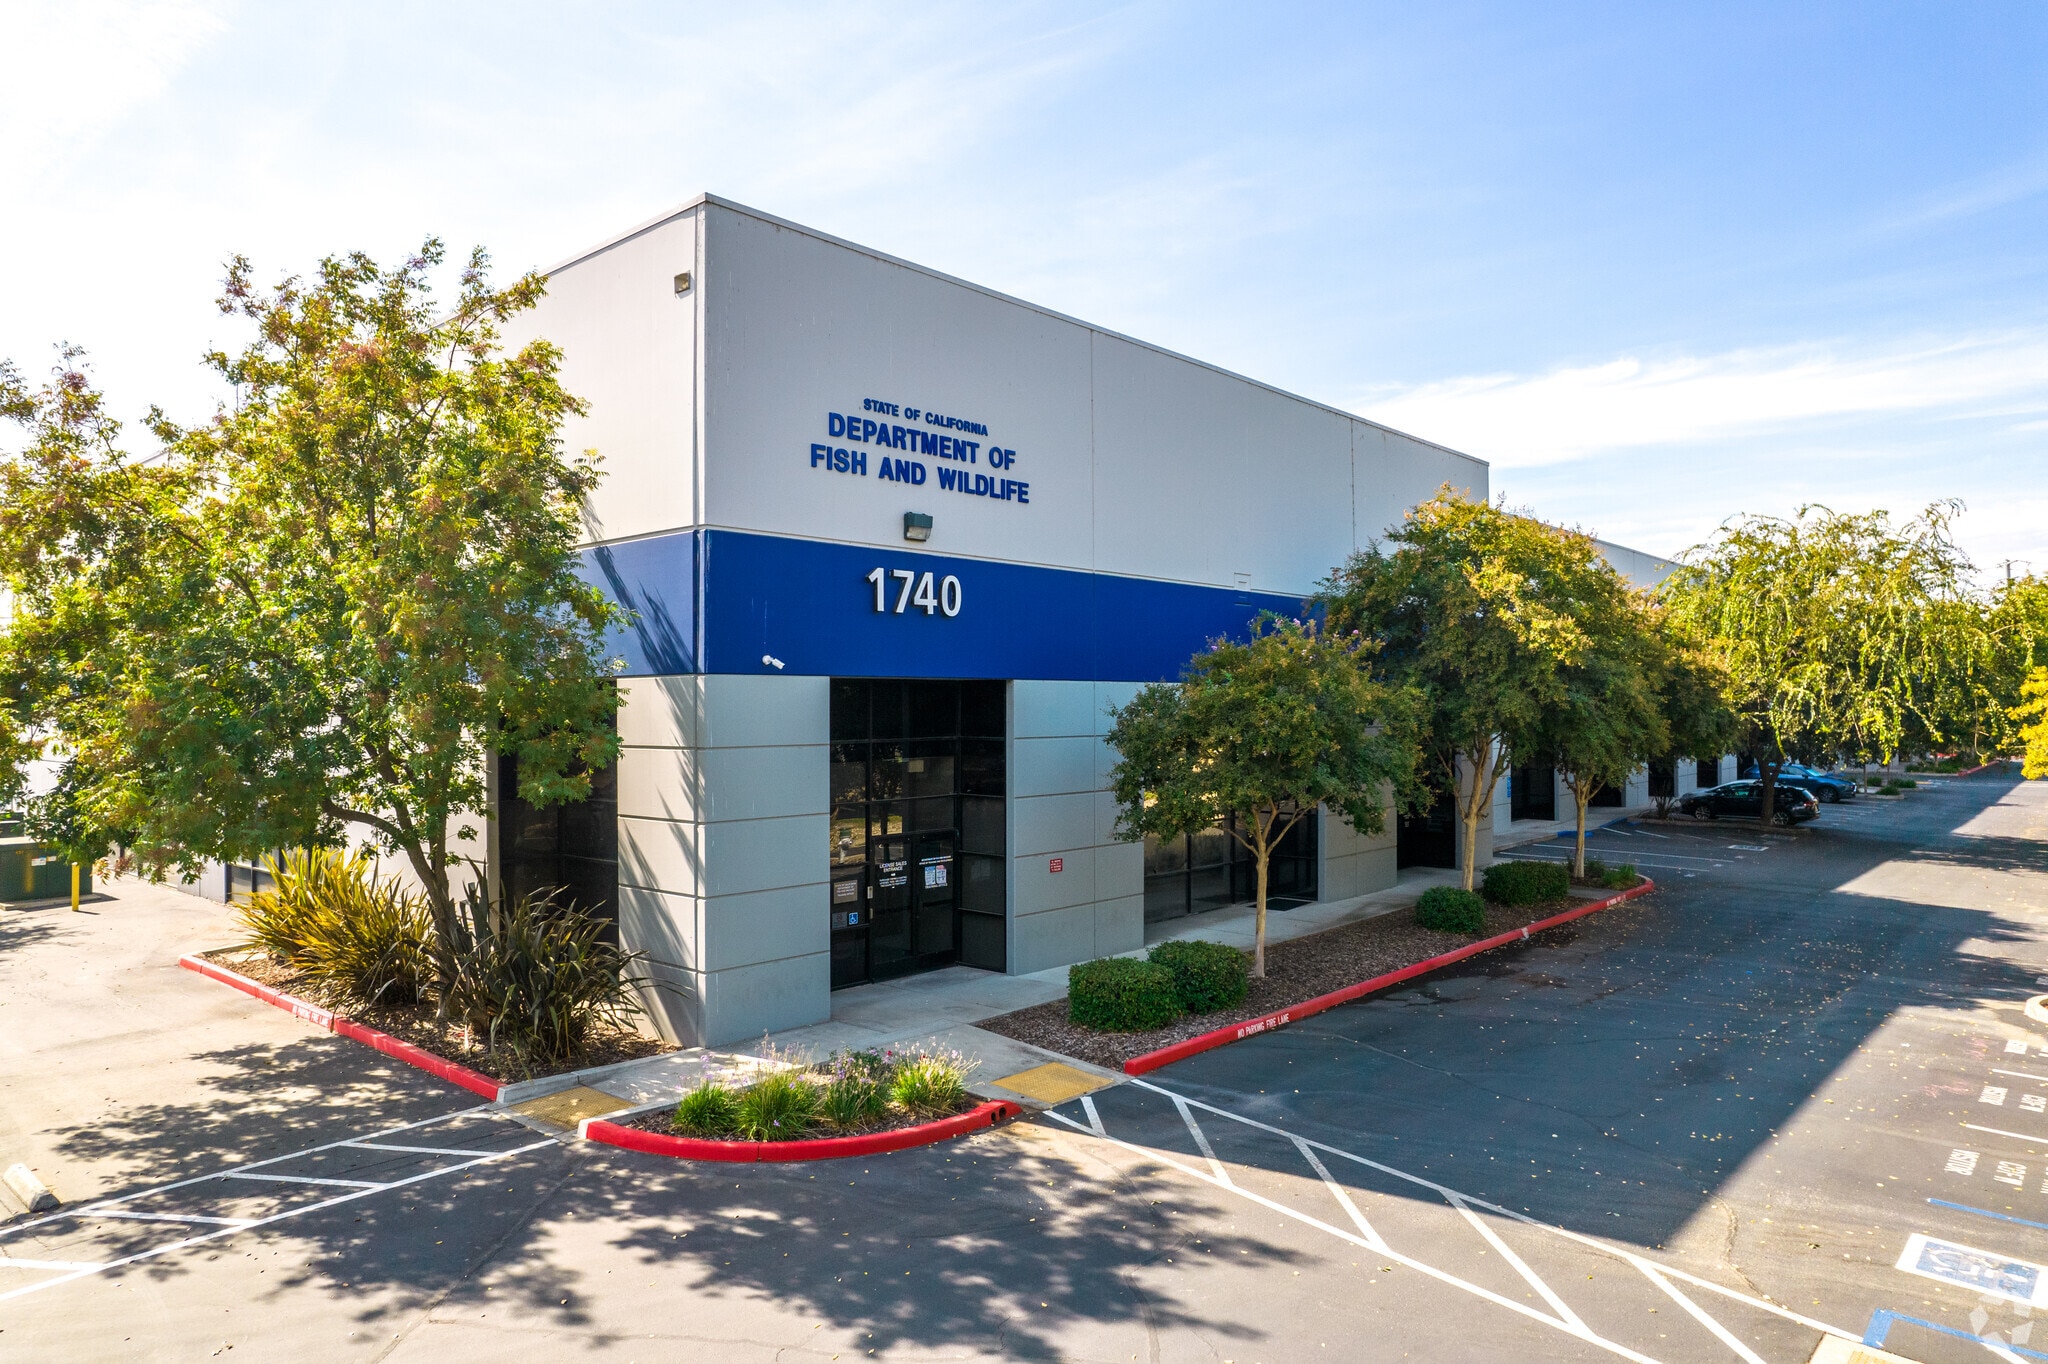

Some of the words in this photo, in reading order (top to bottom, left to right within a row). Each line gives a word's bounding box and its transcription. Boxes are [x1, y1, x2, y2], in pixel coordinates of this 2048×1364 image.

[828, 412, 980, 464] DEPARTMENT
[988, 446, 1016, 470] OF
[863, 398, 899, 417] STATE
[904, 407, 921, 421] OF
[925, 412, 988, 436] CALIFORNIA
[810, 443, 867, 476] FISH
[878, 457, 926, 485] AND
[937, 466, 1030, 504] WILDLIFE
[867, 567, 962, 617] 1740
[1237, 1028, 1245, 1039] NO
[1245, 1021, 1265, 1036] PARKING
[1266, 1017, 1277, 1028] FIRE
[1278, 1013, 1290, 1024] LANE
